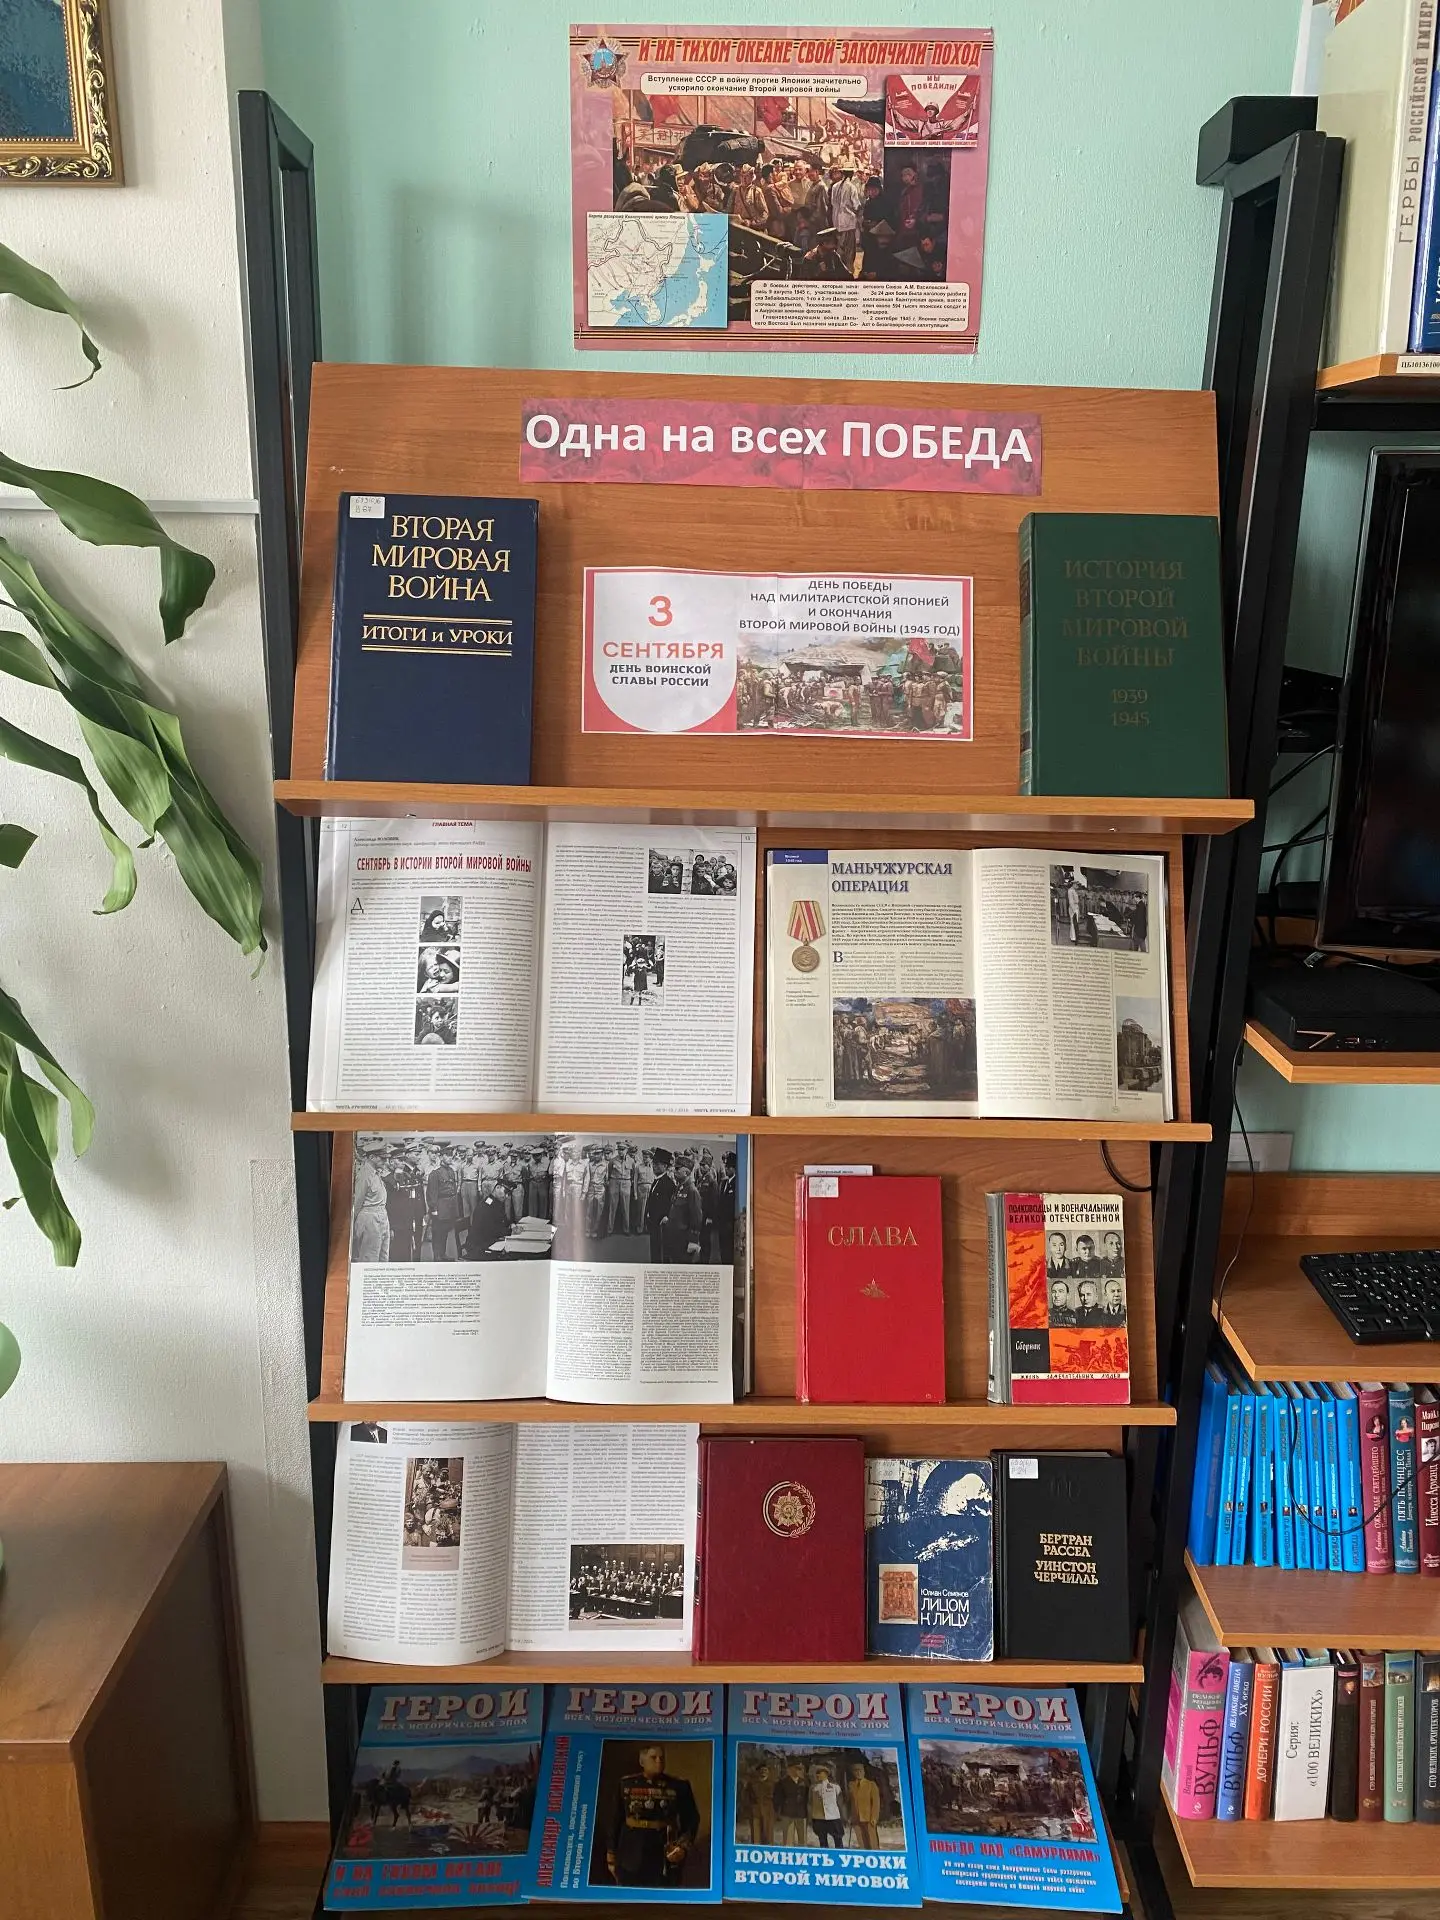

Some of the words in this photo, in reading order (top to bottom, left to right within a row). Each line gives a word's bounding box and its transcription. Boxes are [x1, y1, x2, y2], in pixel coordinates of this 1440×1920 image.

[638, 40, 650, 62] И
[655, 40, 676, 62] НА
[682, 40, 732, 62] ТИХОМ
[736, 40, 793, 63] ОКЕАНЕ
[797, 39, 836, 64] СВОЙ
[840, 42, 928, 64] ЗАКОНЧИЛИ
[931, 43, 982, 67] ПОХОД
[648, 75, 693, 84] Вступление
[726, 76, 749, 84] войну
[912, 83, 957, 92] ПОБЕДИЛИ!
[1399, 155, 1420, 243] ГЕРБЫ
[526, 414, 646, 458] Одна
[662, 424, 715, 453] на
[730, 426, 828, 456] всех
[842, 421, 1034, 469] ПОБЕДА
[391, 515, 495, 542] ВТОРАЯ
[372, 544, 511, 573] МИРОВАЯ
[1064, 560, 1186, 580] ИСТОРИЯ
[388, 574, 493, 602] ВОЙНА
[808, 580, 840, 592] ДЕНЬ
[842, 581, 892, 593] ПОБЕДЫ
[750, 592, 776, 605] НАД
[780, 592, 890, 606] МИЛИТАРИСТСКОЙ
[892, 594, 950, 607] ЯПОНИЕЙ
[1075, 586, 1174, 608] ВТОРОЙ
[648, 594, 674, 628] 3
[808, 607, 816, 618] И
[820, 608, 892, 620] ОКОНЧАНИЯ
[362, 626, 427, 642] ИТОГИ
[432, 632, 444, 643] и
[449, 629, 513, 646] УРОКИ
[740, 618, 787, 632] ВТОРОЙ
[790, 620, 850, 633] МИРОВОЙ
[852, 620, 897, 635] ВОЙНЫ
[899, 623, 931, 636] (1945
[932, 624, 961, 637] ГОД)
[1062, 617, 1190, 638] МИРОВОЙ
[602, 640, 724, 660] СЕНТЯБРЯ
[1076, 646, 1175, 667] ВОЙНЫ
[609, 664, 642, 676] ДЕНЬ
[645, 662, 712, 676] ВОИНСКОЙ
[612, 676, 658, 688] СЛАВЫ
[660, 676, 710, 688] РОССИИ
[1111, 688, 1148, 704] 1939
[1111, 712, 1150, 727] 1945
[356, 857, 390, 871] СЕНТЯБРЬ
[394, 858, 398, 870] В
[400, 856, 433, 870] ИСТОРИИ
[435, 853, 463, 870] ВТОРОЙ
[466, 854, 503, 870] МИРОВОЙ
[506, 856, 532, 873] ВОЙНЫ
[832, 862, 952, 876] МАНЬЧЖУРСКАЯ
[832, 880, 909, 894] ОПЕРАЦИЯ
[1008, 1204, 1052, 1214] ПОЛКОВОДЦЫ
[1054, 1204, 1060, 1212] И
[1061, 1204, 1119, 1212] ВОЕНАЧАЛЬНИКИ
[1050, 1213, 1120, 1223] ОТЕЧЕСТВЕННОЙ
[827, 1226, 919, 1247] СЛАВА
[1015, 1340, 1041, 1354] Сборник
[1372, 1446, 1380, 1494] СВЕТЛЕЙШЕГО
[1425, 1464, 1439, 1496] Арманд
[1398, 1500, 1406, 1522] ПЯТЬ
[1426, 1498, 1439, 1527] Инесса
[1040, 1533, 1093, 1546] БЕРТРАН
[1044, 1545, 1091, 1558] РАССЕЛ
[1036, 1560, 1097, 1574] УИНСТОН
[1034, 1572, 1099, 1585] ЧЕРЧИЛЛЬ
[921, 1598, 969, 1614] ЛИЦОМ
[920, 1612, 931, 1626] К
[933, 1612, 970, 1629] ЛИЦУ
[1233, 1668, 1241, 1694] ИМЕНА
[380, 1688, 530, 1722] ГЕРОИ
[566, 1687, 713, 1716] ГЕРОИ
[743, 1690, 889, 1720] ГЕРОИ
[922, 1690, 1071, 1722] ГЕРОИ
[1230, 1694, 1239, 1728] ВЕЛИКИЕ
[1239, 1702, 1248, 1716] ХХ
[1260, 1685, 1272, 1733] РОССИИ
[594, 1715, 680, 1724] ИСТОРИЧЕСКИХ
[772, 1718, 857, 1729] ИСТОРИЧЕСКИХ
[954, 1718, 1039, 1730] ИСТОРИЧЕСКИХ
[1044, 1723, 1072, 1731] ЭПОХ
[1308, 1689, 1323, 1759] ВЕЛИКИХ»
[1430, 1699, 1439, 1744] АРХИТЕКТОРОВ
[1286, 1722, 1302, 1759] Серия:
[1194, 1719, 1220, 1796] ВУЛЬФ
[1224, 1731, 1244, 1791] ВУЛЬФ
[1257, 1738, 1268, 1782] ДОЧЕРИ
[1430, 1746, 1438, 1774] ВЕЛИКИХ
[1307, 1762, 1319, 1787] «100
[536, 1816, 562, 1886] АЛЕКСАНДР
[735, 1850, 835, 1867] ПОМНИТЬ
[839, 1855, 907, 1870] УРОКИ
[980, 1844, 1005, 1859] НАД
[735, 1870, 810, 1886] ВТОРОЙ
[815, 1874, 910, 1890] МИРОВОЙ
